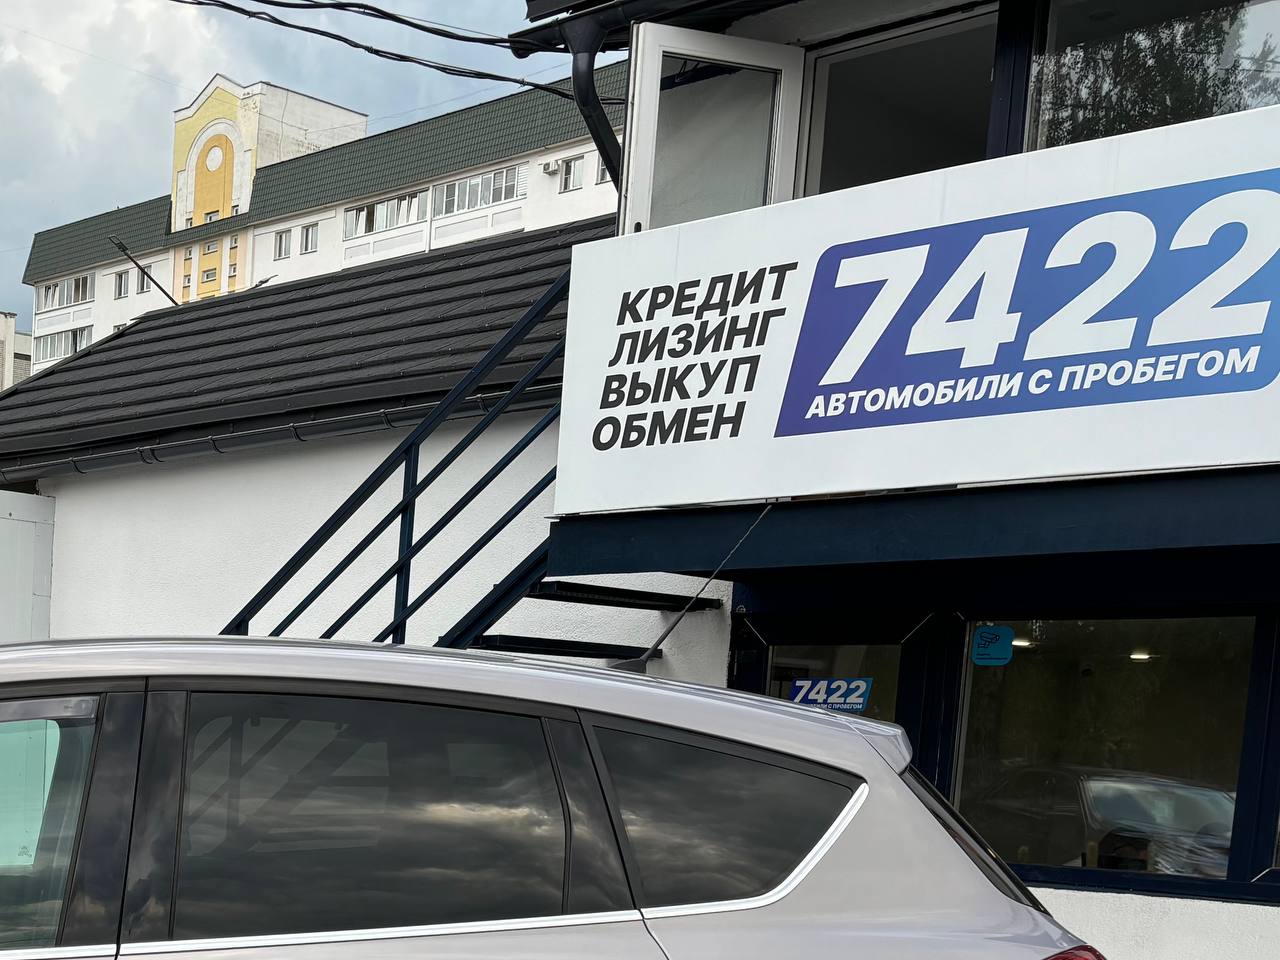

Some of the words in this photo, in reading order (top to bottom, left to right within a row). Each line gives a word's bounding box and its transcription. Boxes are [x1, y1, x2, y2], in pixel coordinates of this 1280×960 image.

[616, 262, 799, 326] КРЕДИТ
[818, 188, 1280, 386] 7422
[607, 308, 787, 368] ЛИЗИНГ
[599, 355, 762, 410] ВЫКУП
[804, 371, 1024, 420] АВТОМОБИЛИ
[1028, 369, 1053, 395] С
[1058, 345, 1261, 392] ПРОБЕГОМ
[592, 401, 747, 452] ОБМЕН
[793, 680, 867, 704] 7422
